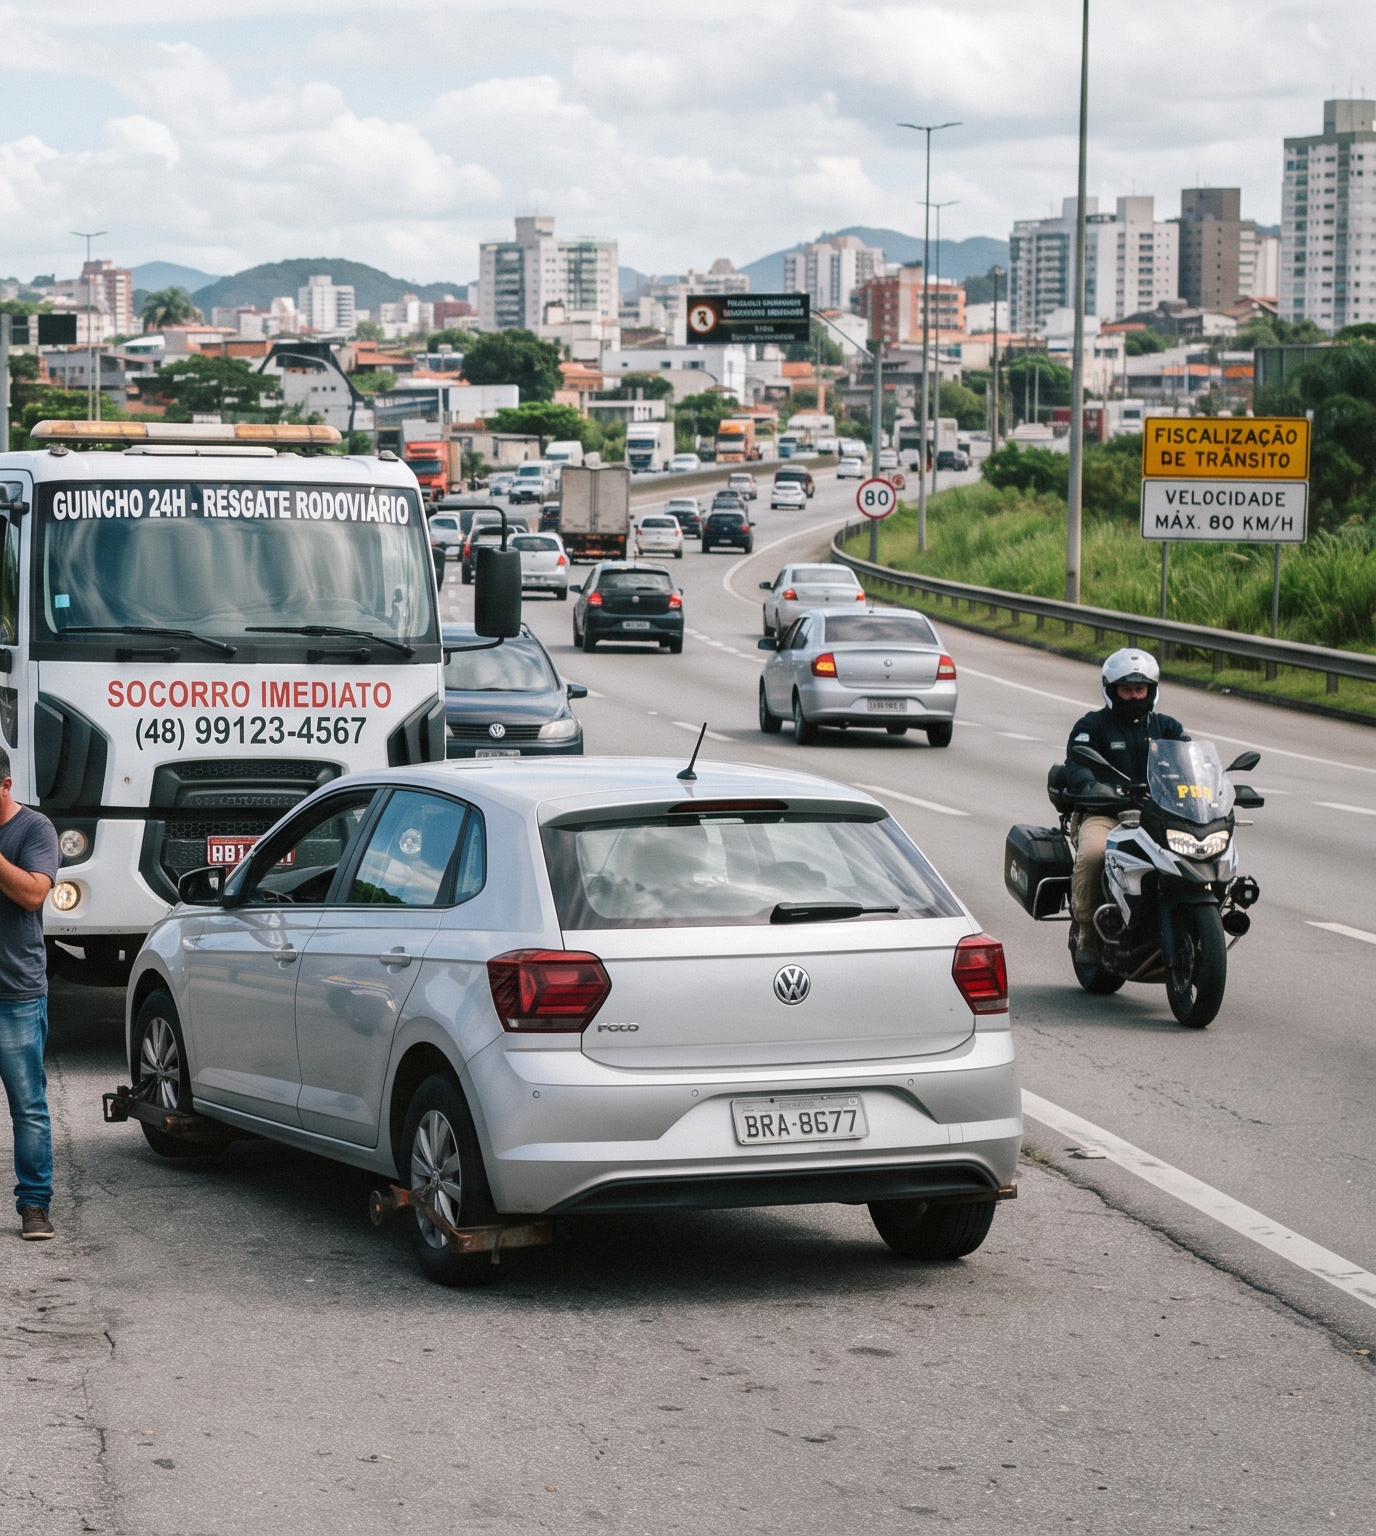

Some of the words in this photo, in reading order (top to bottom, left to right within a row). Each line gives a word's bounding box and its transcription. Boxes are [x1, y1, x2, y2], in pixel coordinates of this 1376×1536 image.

[1155, 424, 1298, 448] FISCALIZAÇÃO
[1161, 450, 1186, 467] DE
[1195, 447, 1290, 468] TRÂNSITO
[52, 489, 143, 520] GUINCHO
[149, 488, 186, 518] 24H
[203, 489, 291, 519] RESGATE
[296, 486, 409, 525] RODOVIÁRIO
[864, 489, 889, 506] 80
[1165, 489, 1286, 507] VELOCIDADE
[1155, 509, 1201, 530] MÁX.
[1209, 515, 1234, 530] 80
[1243, 515, 1293, 532] KM/H
[107, 680, 250, 708] SOCORRO
[261, 681, 392, 708] IMEDIATO
[135, 717, 186, 750] (48)
[195, 716, 367, 745] 99123-4567
